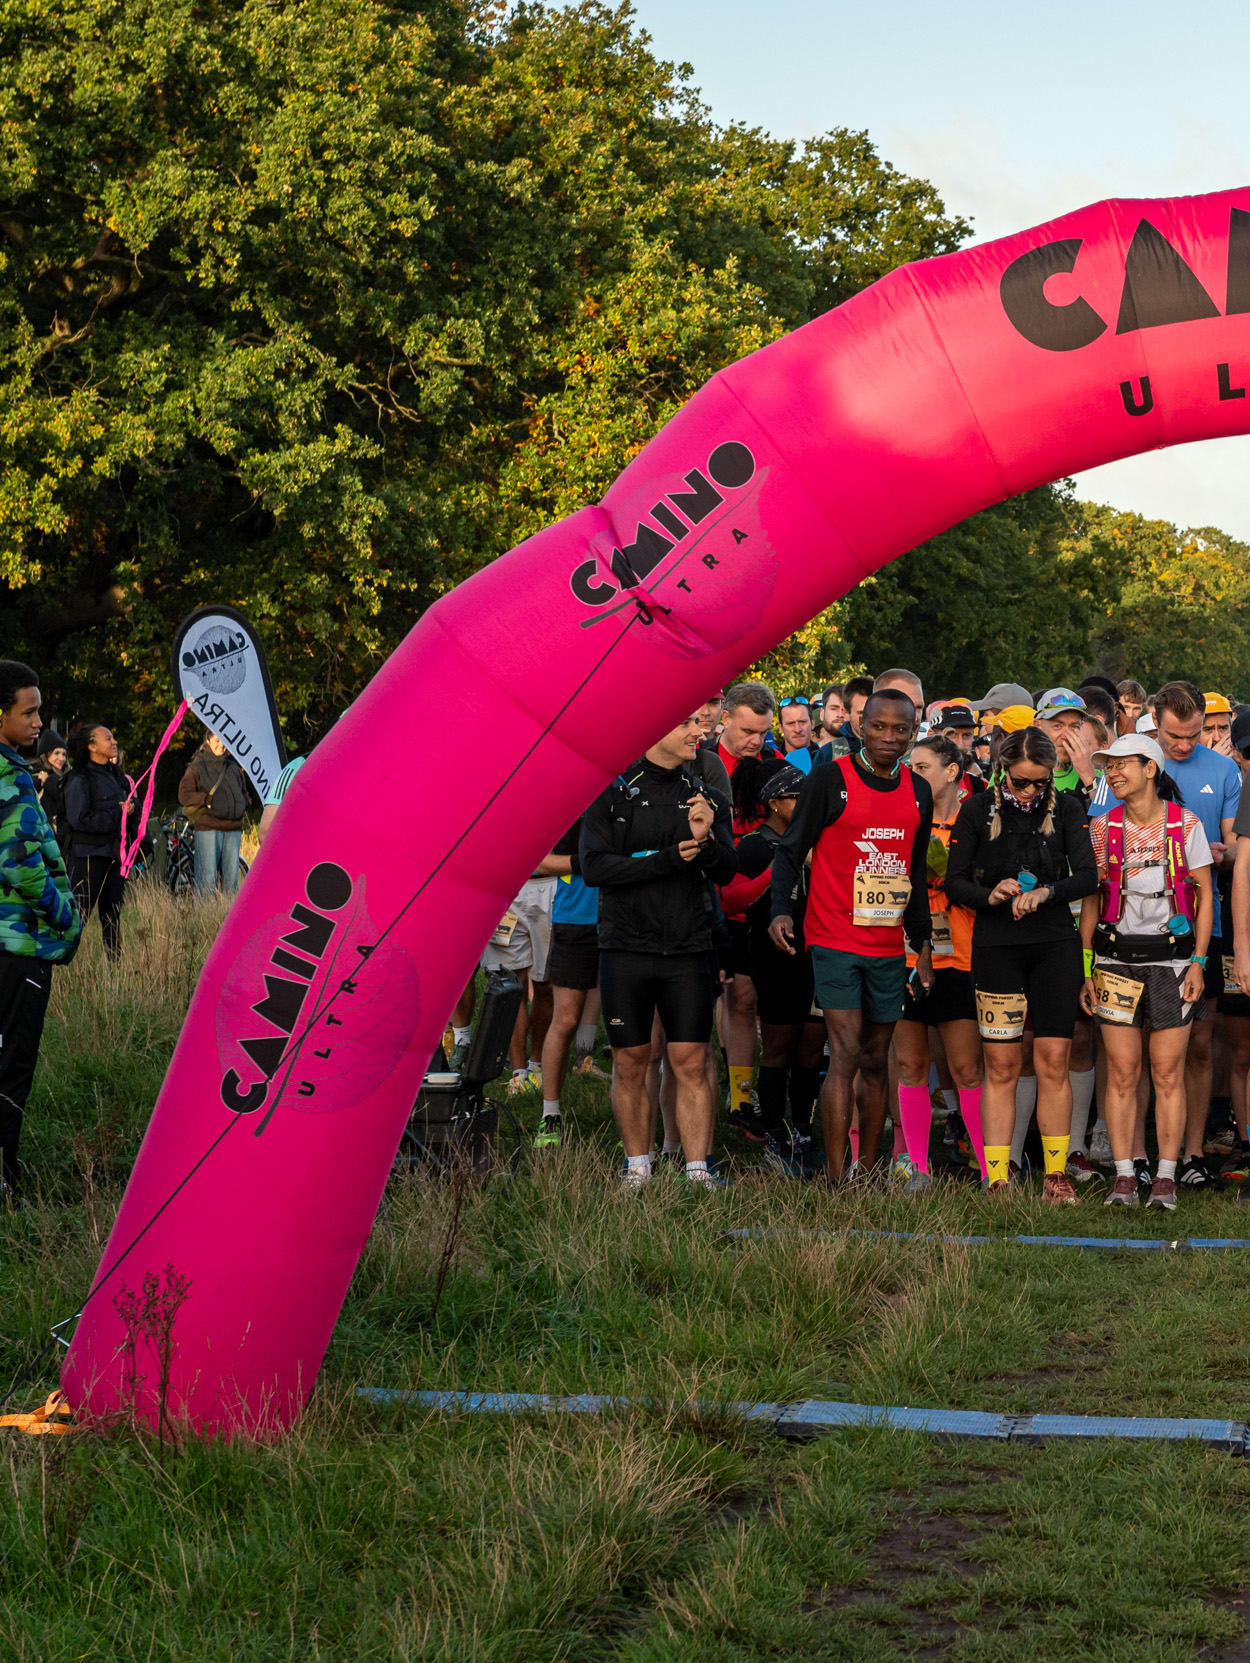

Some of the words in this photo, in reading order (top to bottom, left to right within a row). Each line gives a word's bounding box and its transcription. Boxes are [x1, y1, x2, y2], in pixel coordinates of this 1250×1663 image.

[570, 440, 756, 606] CAMINO
[862, 827, 905, 841] JOSEPH
[858, 859, 906, 868] LONDON
[868, 852, 899, 861] EAST
[855, 866, 907, 875] RUNNERS
[857, 891, 886, 905] 180
[979, 1008, 995, 1024] 10
